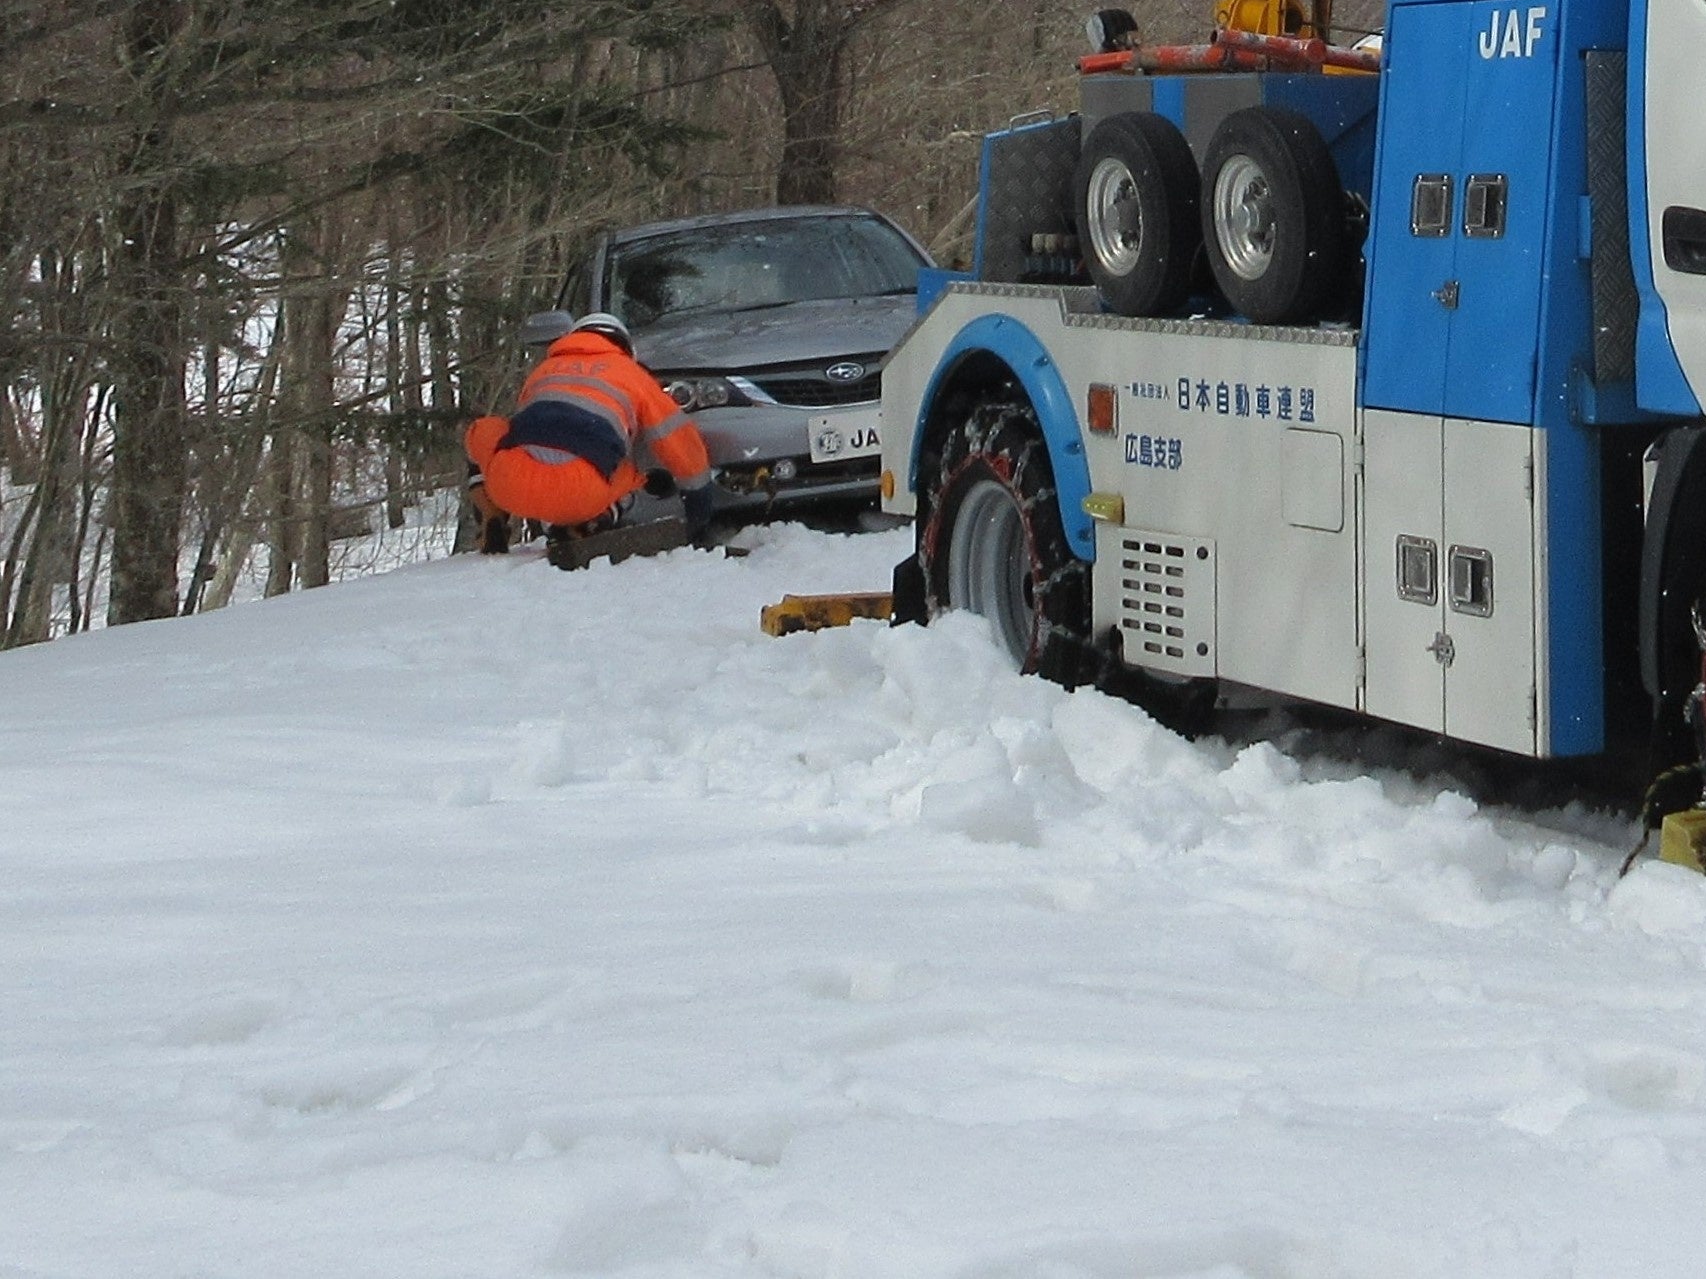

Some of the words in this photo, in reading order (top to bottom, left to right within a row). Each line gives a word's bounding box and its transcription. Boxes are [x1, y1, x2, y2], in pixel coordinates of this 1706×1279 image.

[1479, 7, 1546, 59] JAF
[1178, 377, 1315, 422] 日本自動車連盟
[1124, 432, 1183, 470] 広島支部
